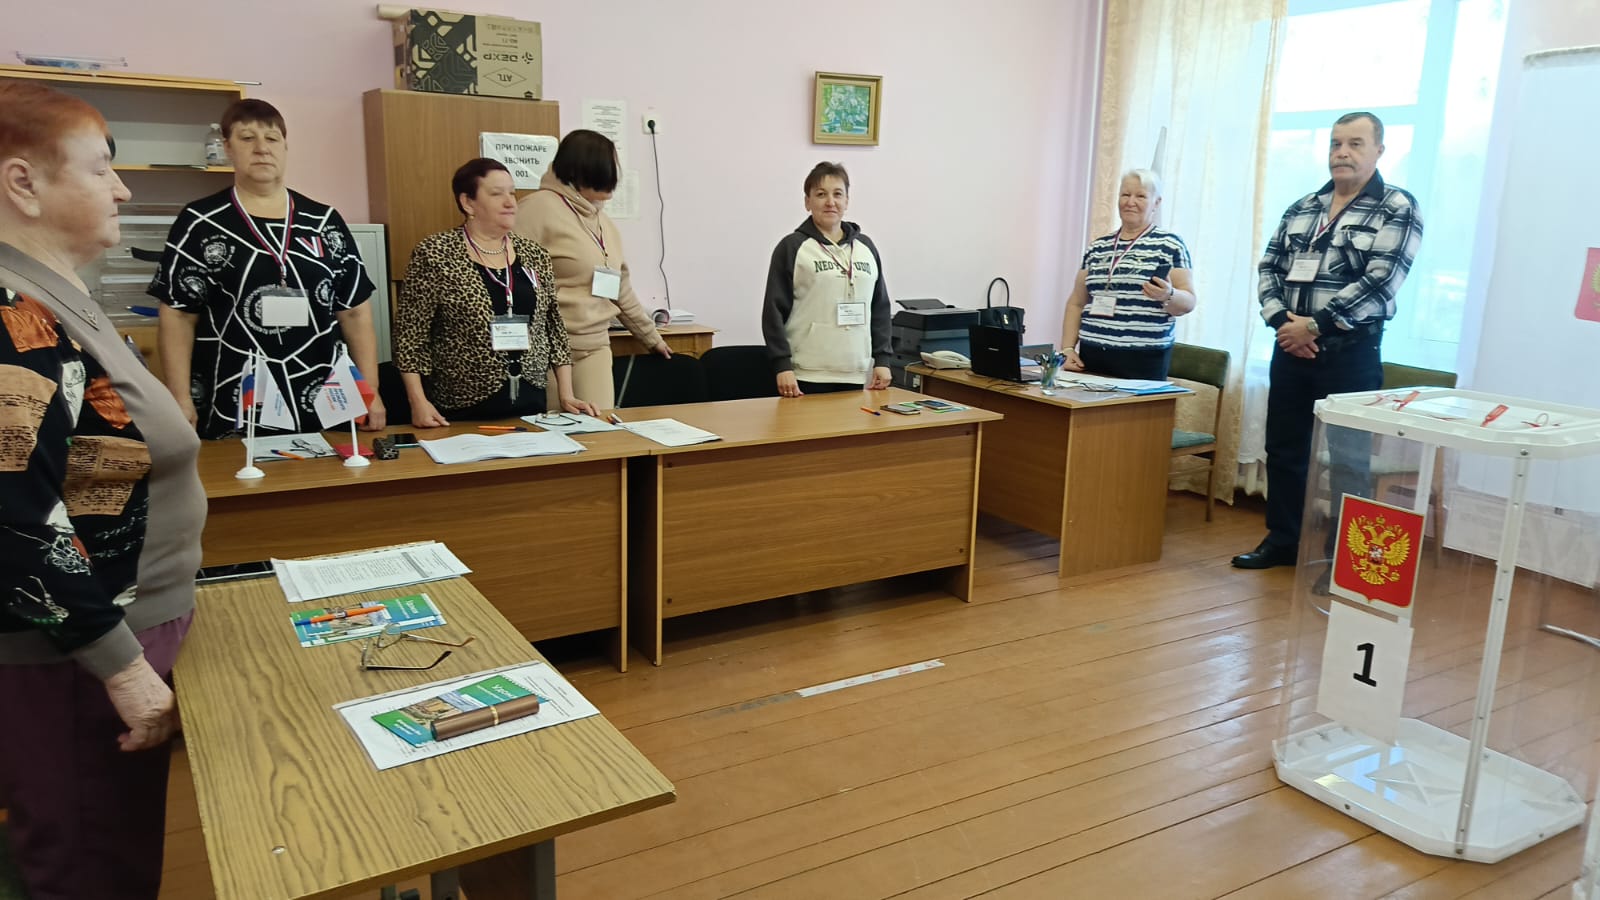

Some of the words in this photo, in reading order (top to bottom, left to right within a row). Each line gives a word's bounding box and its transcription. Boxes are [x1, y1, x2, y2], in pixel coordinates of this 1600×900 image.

[483, 53, 518, 62] DEXP
[497, 74, 512, 82] ATL
[495, 143, 512, 151] ПРИ
[514, 144, 548, 153] ПОЖАРЕ
[504, 156, 540, 165] ЗВОНИТЬ
[515, 170, 529, 178] 001
[1353, 642, 1377, 687] 1
